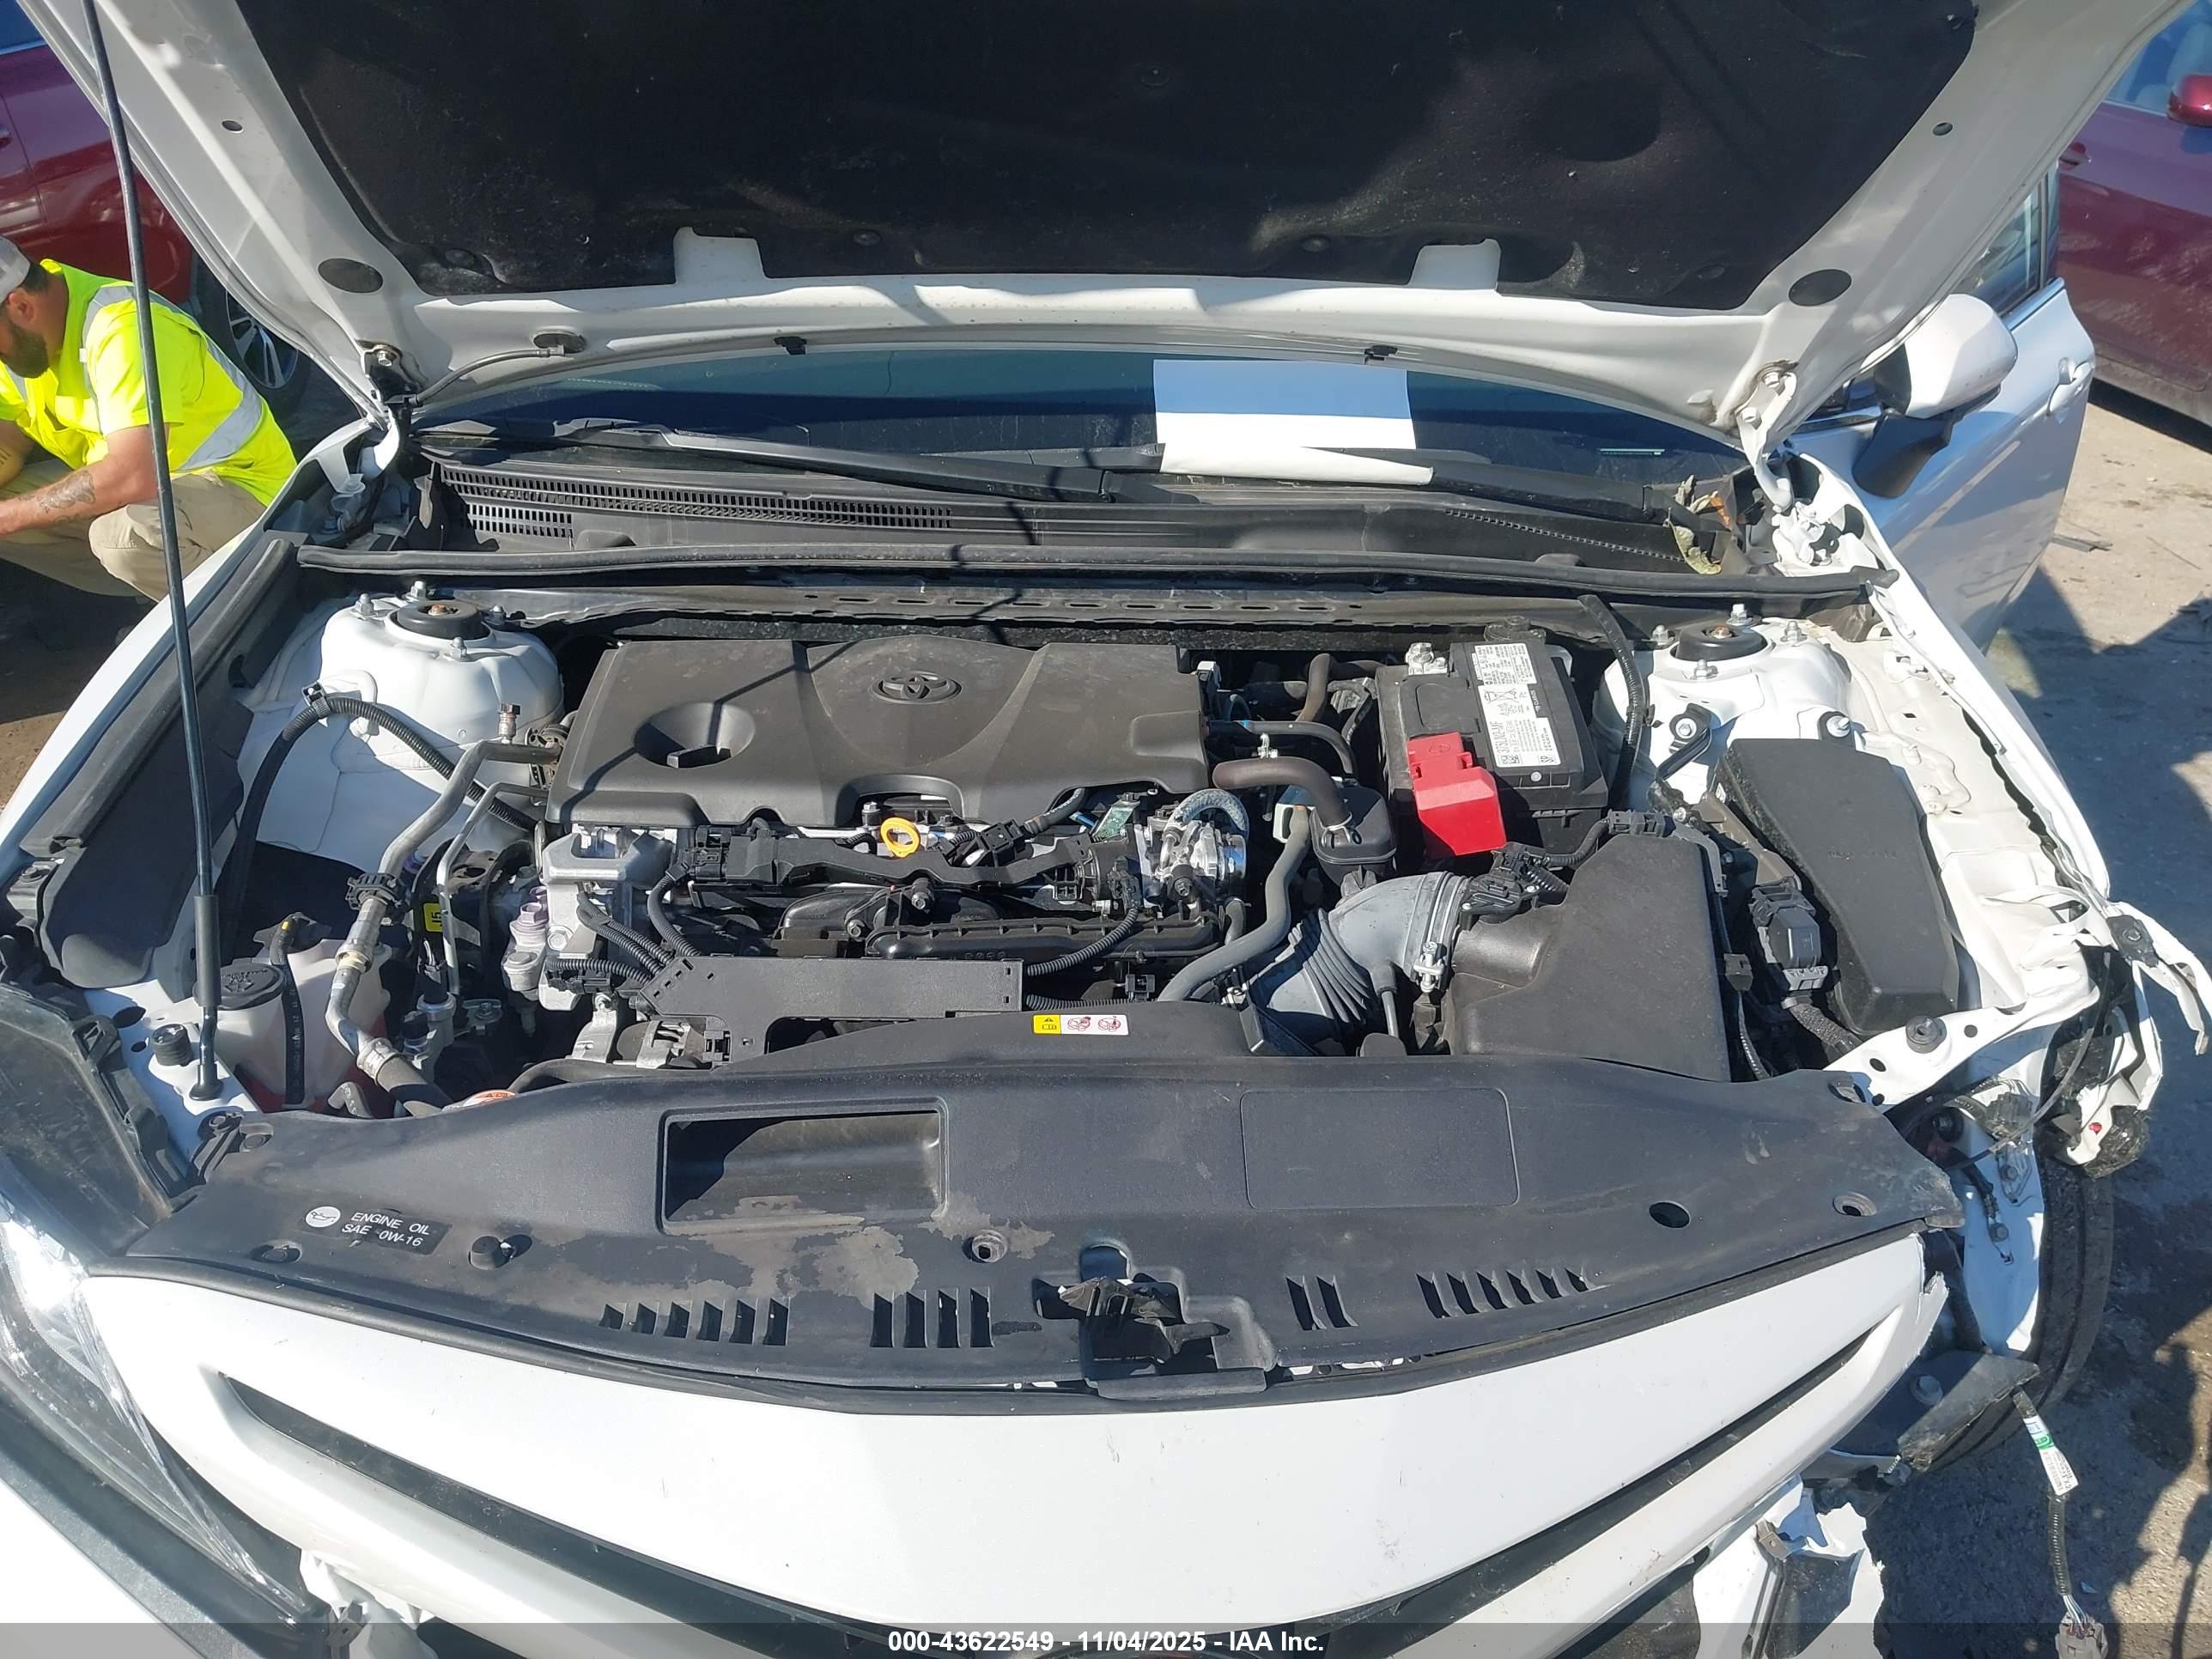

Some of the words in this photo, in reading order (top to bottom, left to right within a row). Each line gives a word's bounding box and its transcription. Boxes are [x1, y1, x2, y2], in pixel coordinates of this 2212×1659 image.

[342, 1224, 373, 1235] SAE
[378, 1230, 423, 1248] 0W-16
[350, 1212, 404, 1230] ENGINE
[409, 1223, 431, 1236] OIL
